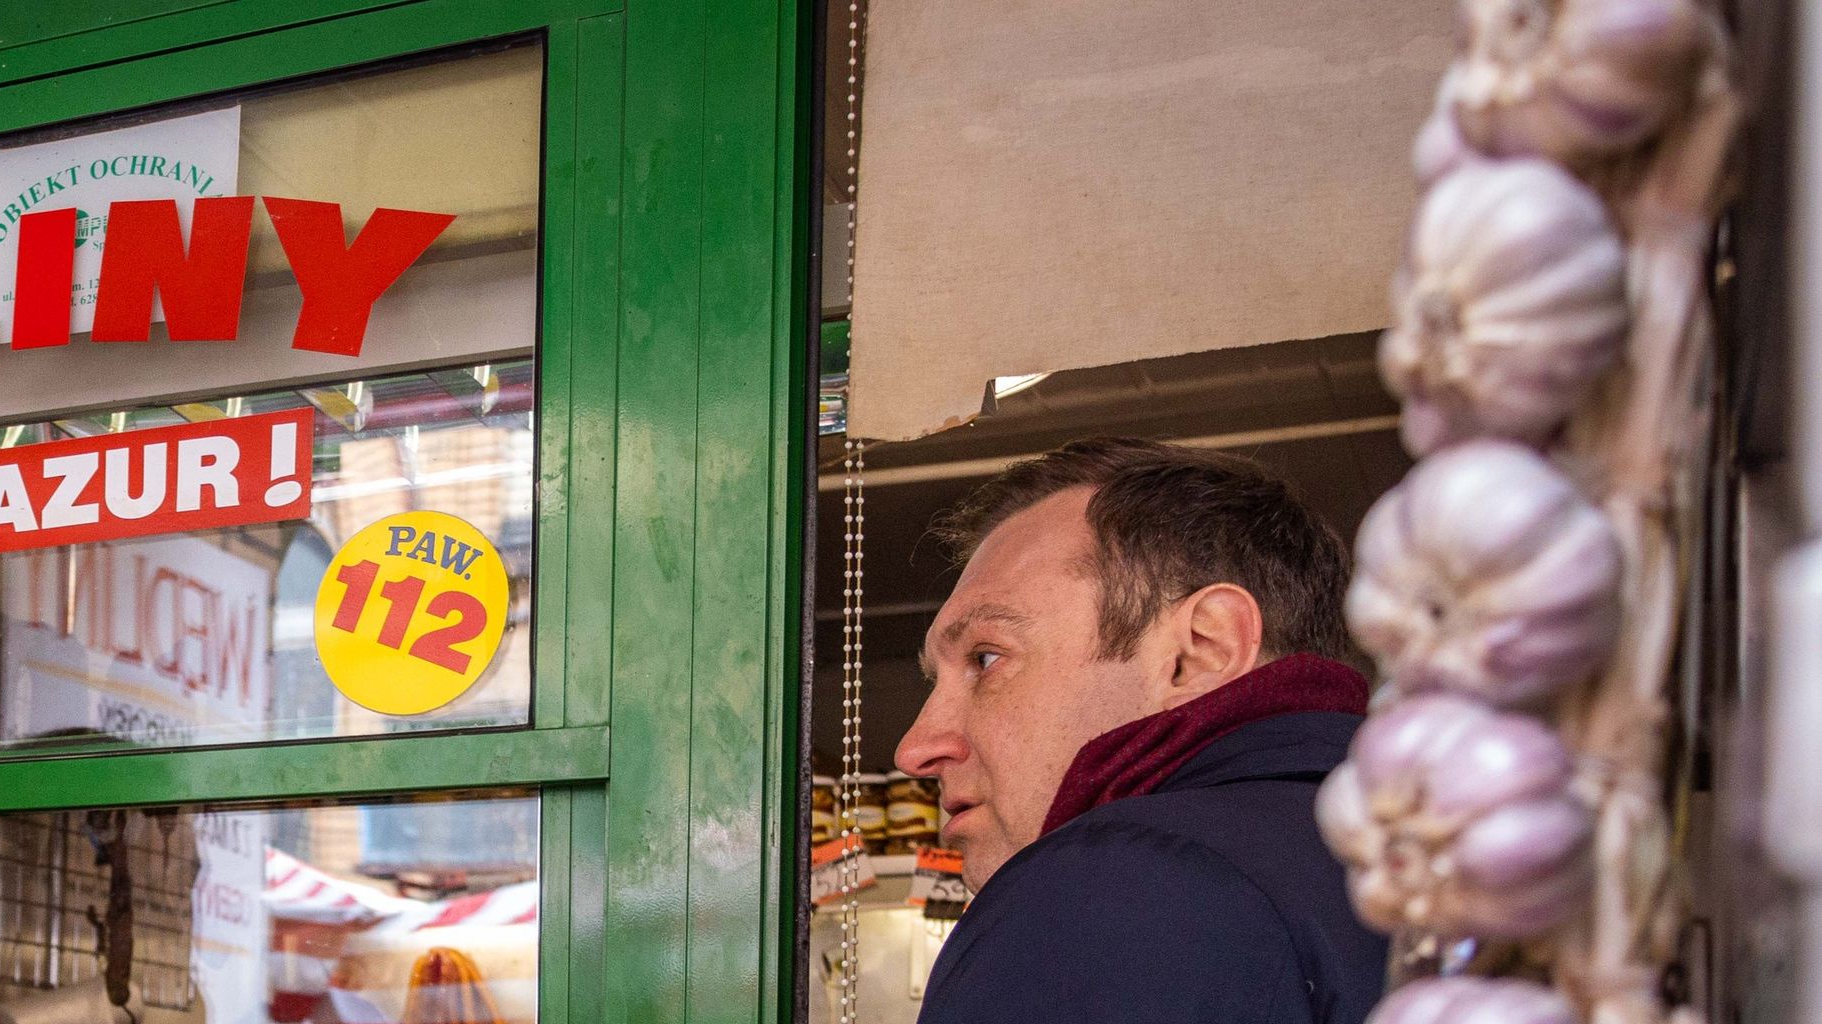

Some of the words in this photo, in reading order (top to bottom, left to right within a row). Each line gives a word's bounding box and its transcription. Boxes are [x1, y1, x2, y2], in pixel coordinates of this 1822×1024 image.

[89, 155, 223, 197] OCHRANI
[385, 526, 483, 581] PAW.
[332, 559, 488, 675] 112
